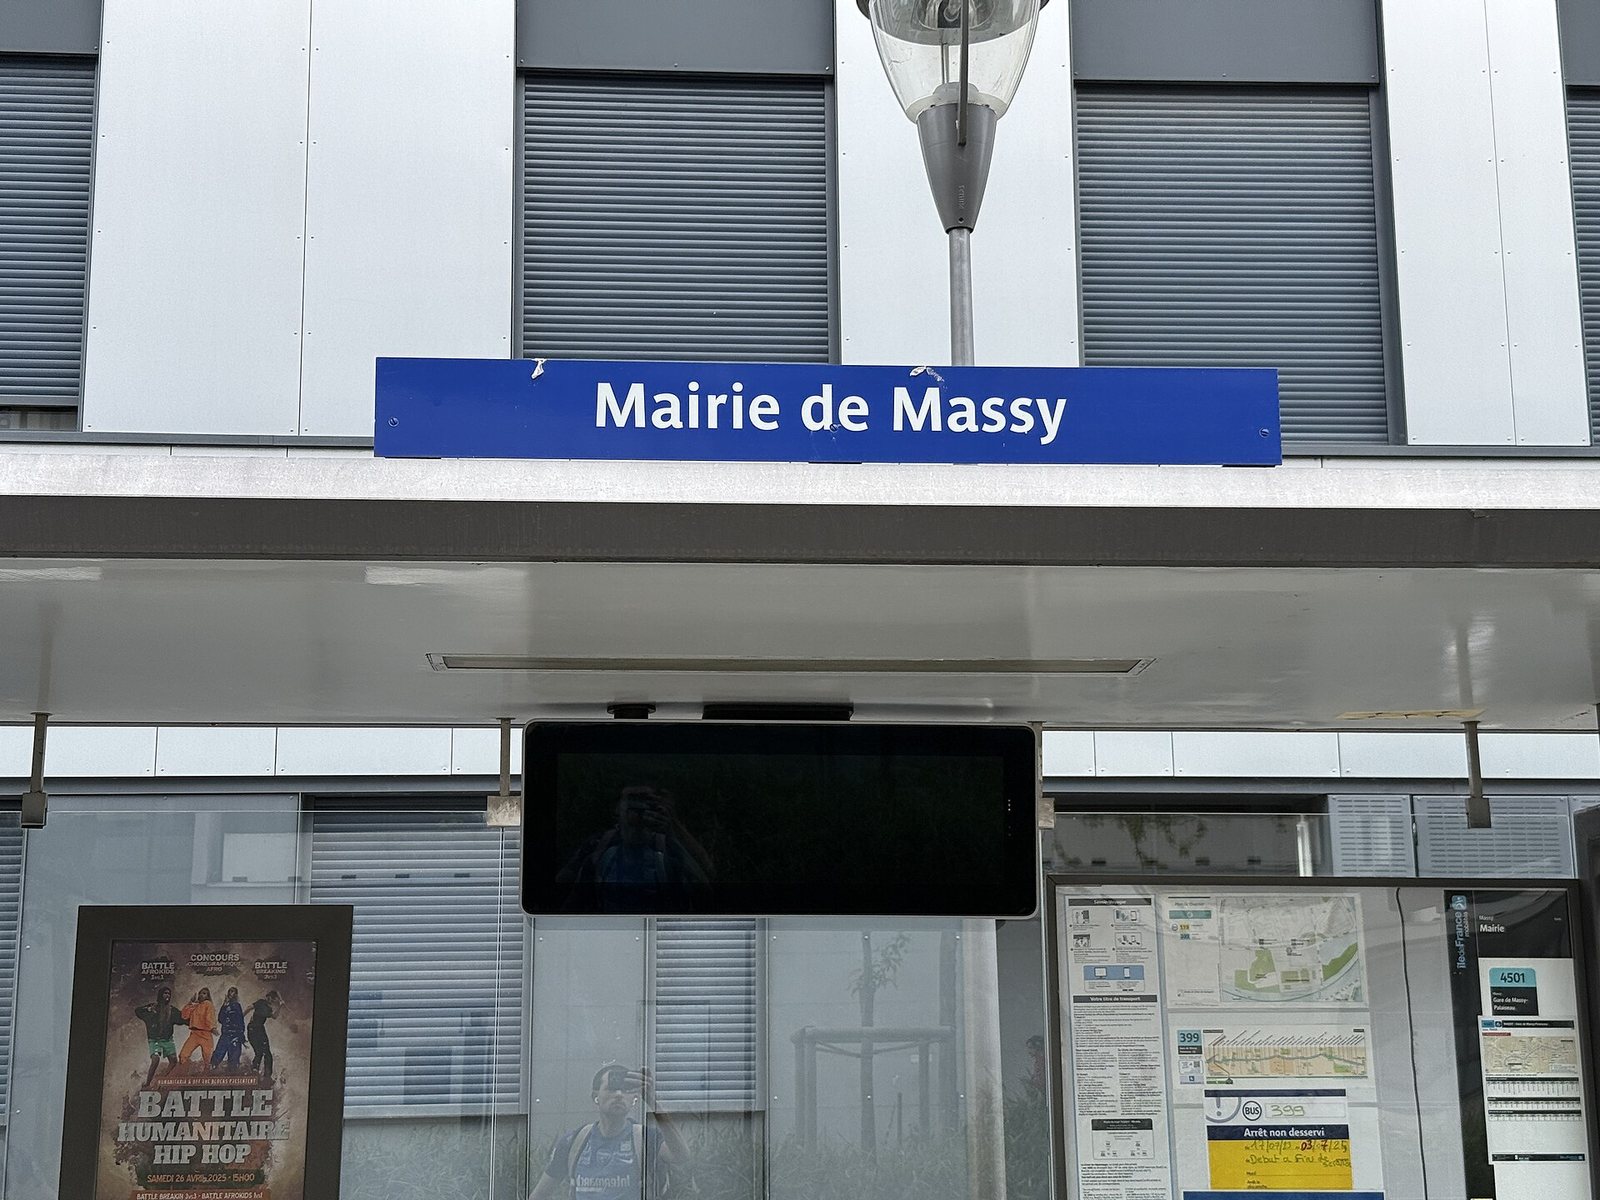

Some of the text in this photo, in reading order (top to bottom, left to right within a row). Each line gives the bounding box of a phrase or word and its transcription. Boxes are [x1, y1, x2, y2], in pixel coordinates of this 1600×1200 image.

[595, 381, 1067, 445] Mairie de Massy
[1479, 923, 1505, 933] Mairie
[190, 953, 240, 962] CONCOURS
[141, 962, 175, 970] BATTLE
[255, 961, 288, 969] BATTLE
[1500, 972, 1525, 983] 4501
[1179, 1032, 1200, 1043] 399
[138, 1089, 274, 1118] BATTLE
[1245, 1106, 1260, 1115] BUS
[1271, 1104, 1305, 1117] 399
[117, 1121, 290, 1142] HUMANITAIRE
[1243, 1127, 1325, 1137] Arrêt non desservi
[153, 1144, 251, 1164] HIP HOP
[147, 1174, 174, 1183] SAMEDI
[175, 1174, 185, 1183] 26
[207, 1173, 227, 1182] 2025
[232, 1173, 255, 1182] 15H00
